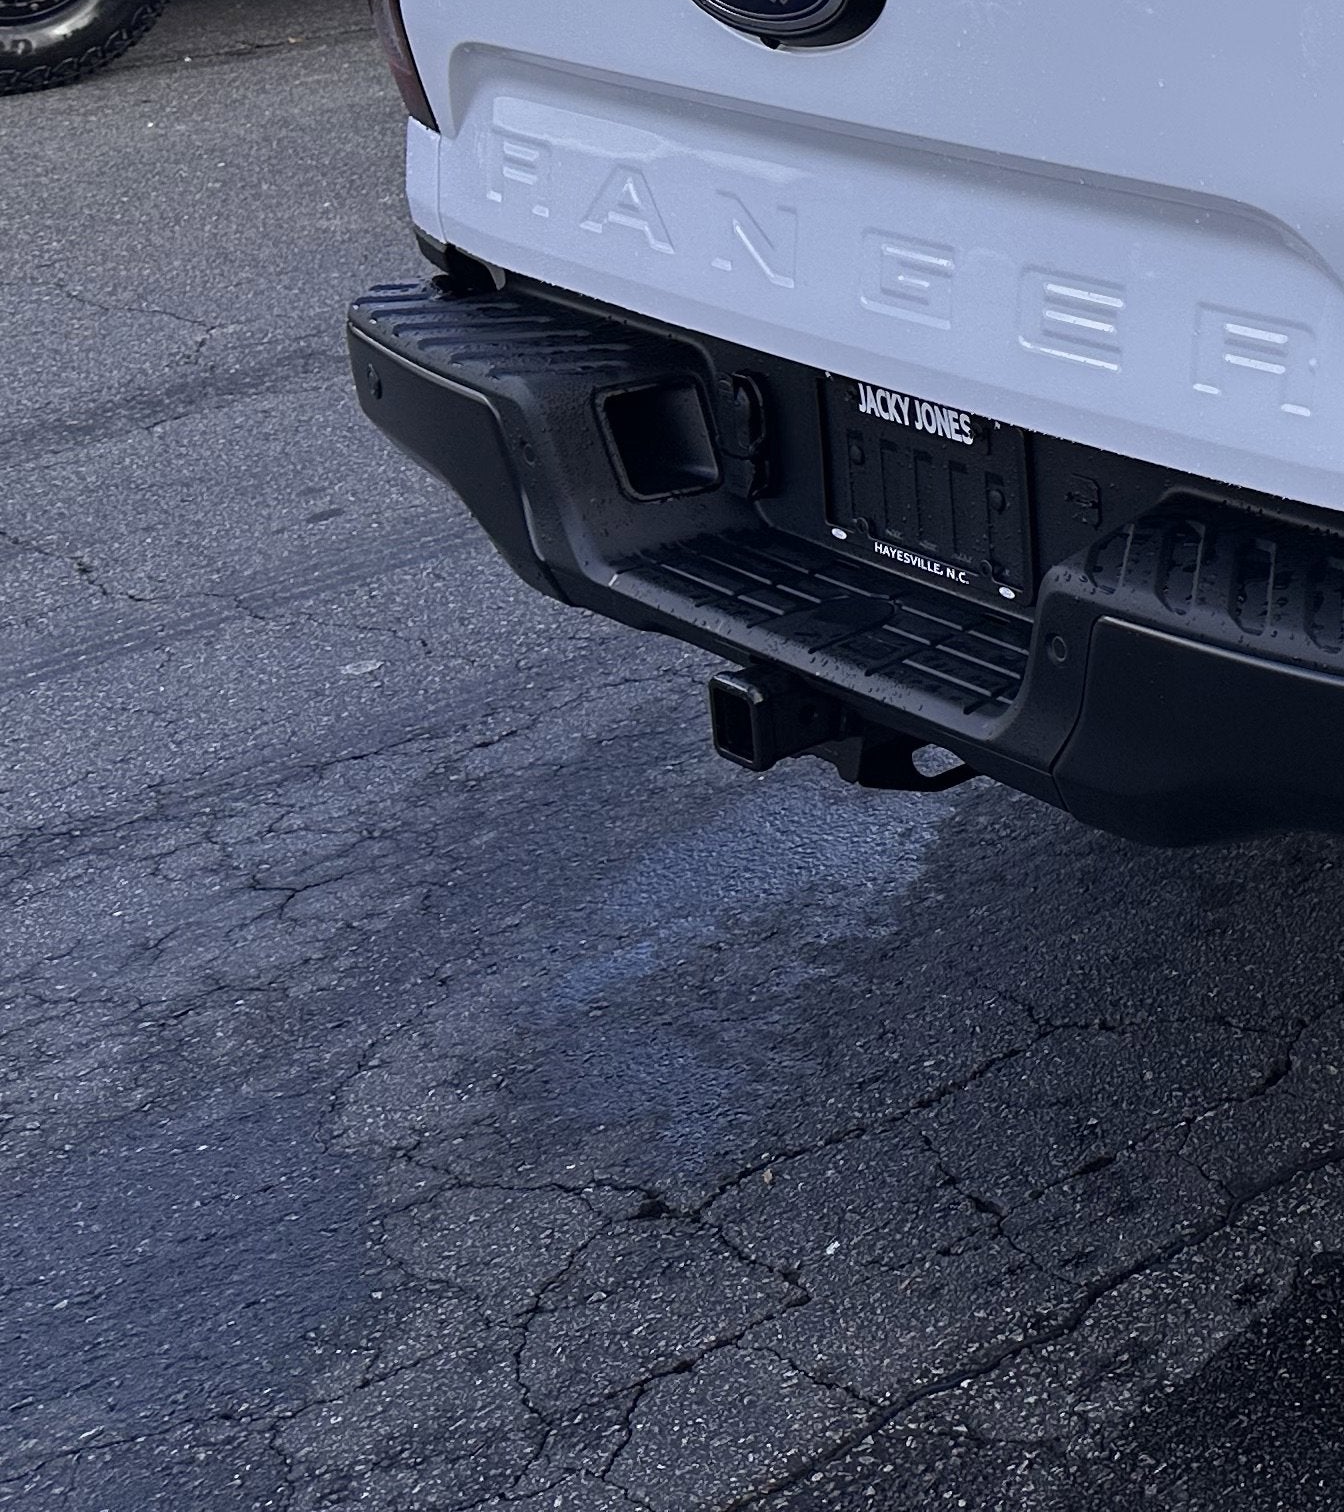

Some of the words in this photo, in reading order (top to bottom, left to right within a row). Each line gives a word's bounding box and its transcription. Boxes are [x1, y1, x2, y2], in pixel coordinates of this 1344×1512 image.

[484, 132, 1319, 418] RANGER
[858, 382, 910, 426] JACKY
[914, 399, 974, 445] JONES
[946, 567, 970, 585] N.C.
